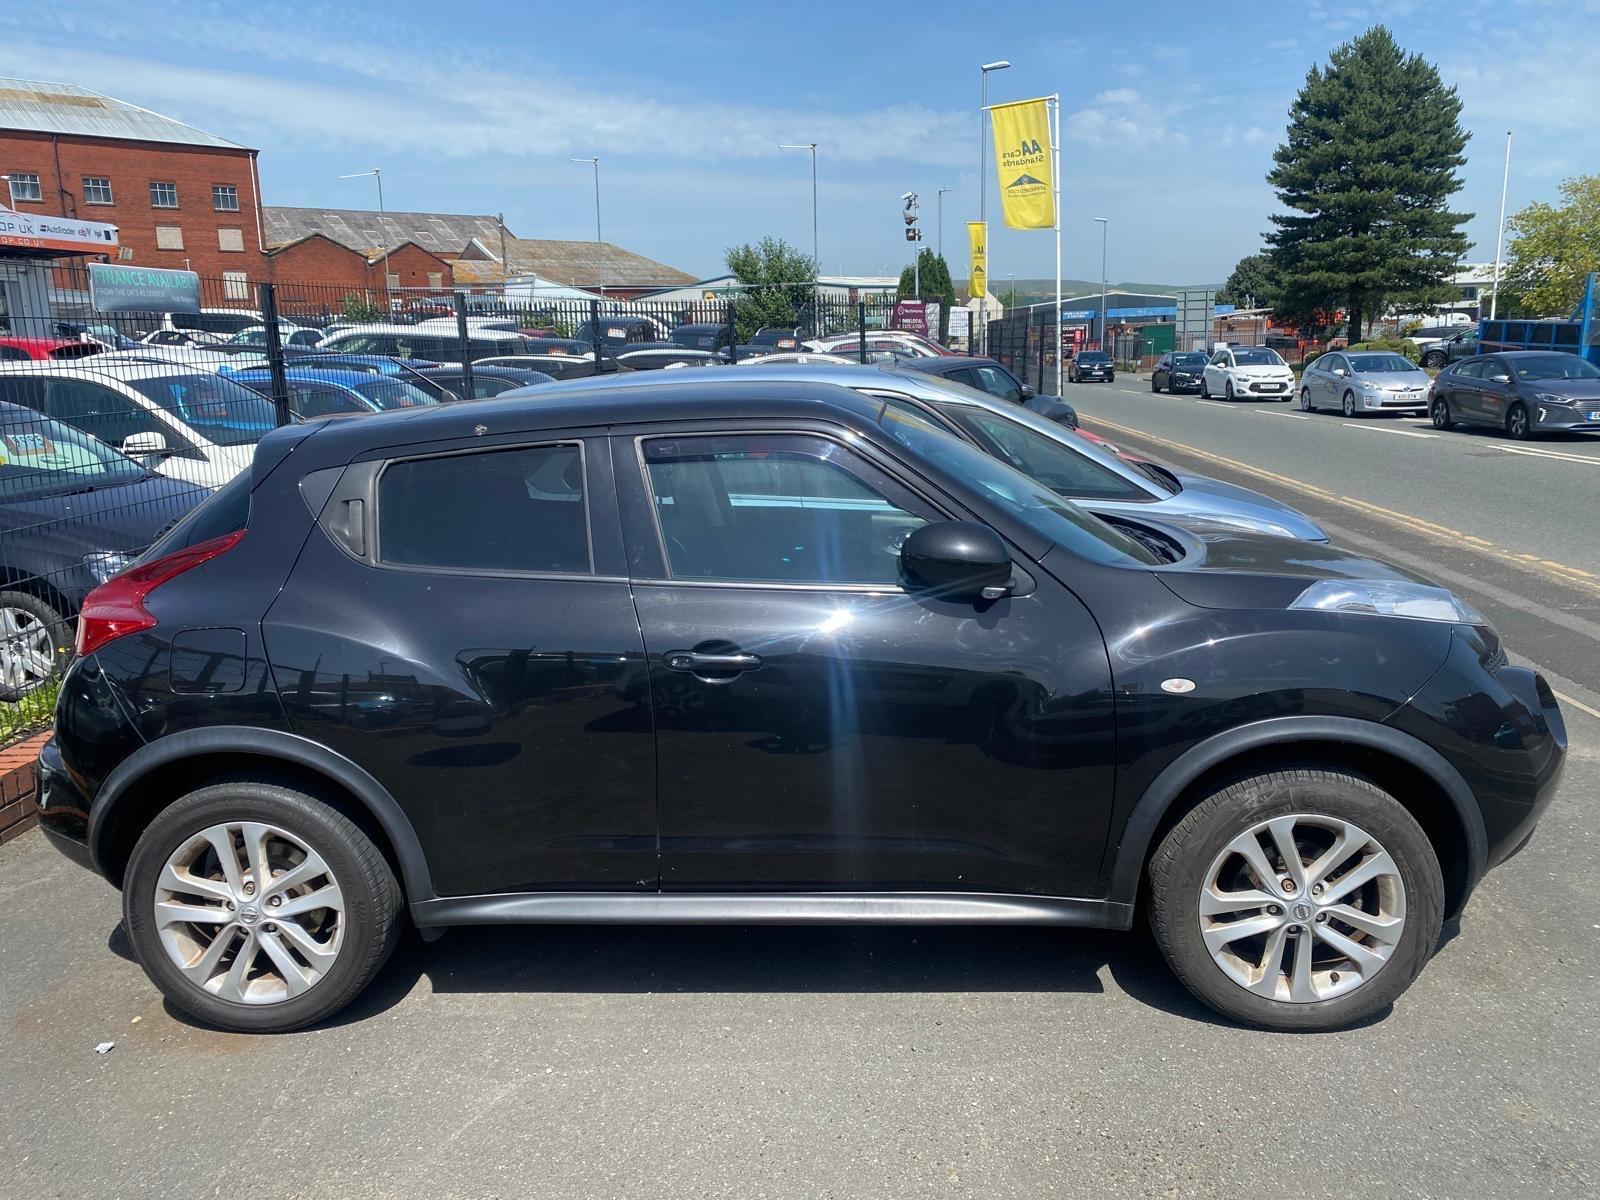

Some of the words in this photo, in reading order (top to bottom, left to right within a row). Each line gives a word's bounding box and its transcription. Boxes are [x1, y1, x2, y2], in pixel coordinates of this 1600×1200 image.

[19, 225, 34, 234] UK
[95, 267, 146, 287] FINANCE
[148, 271, 198, 289] AVAILABLE
